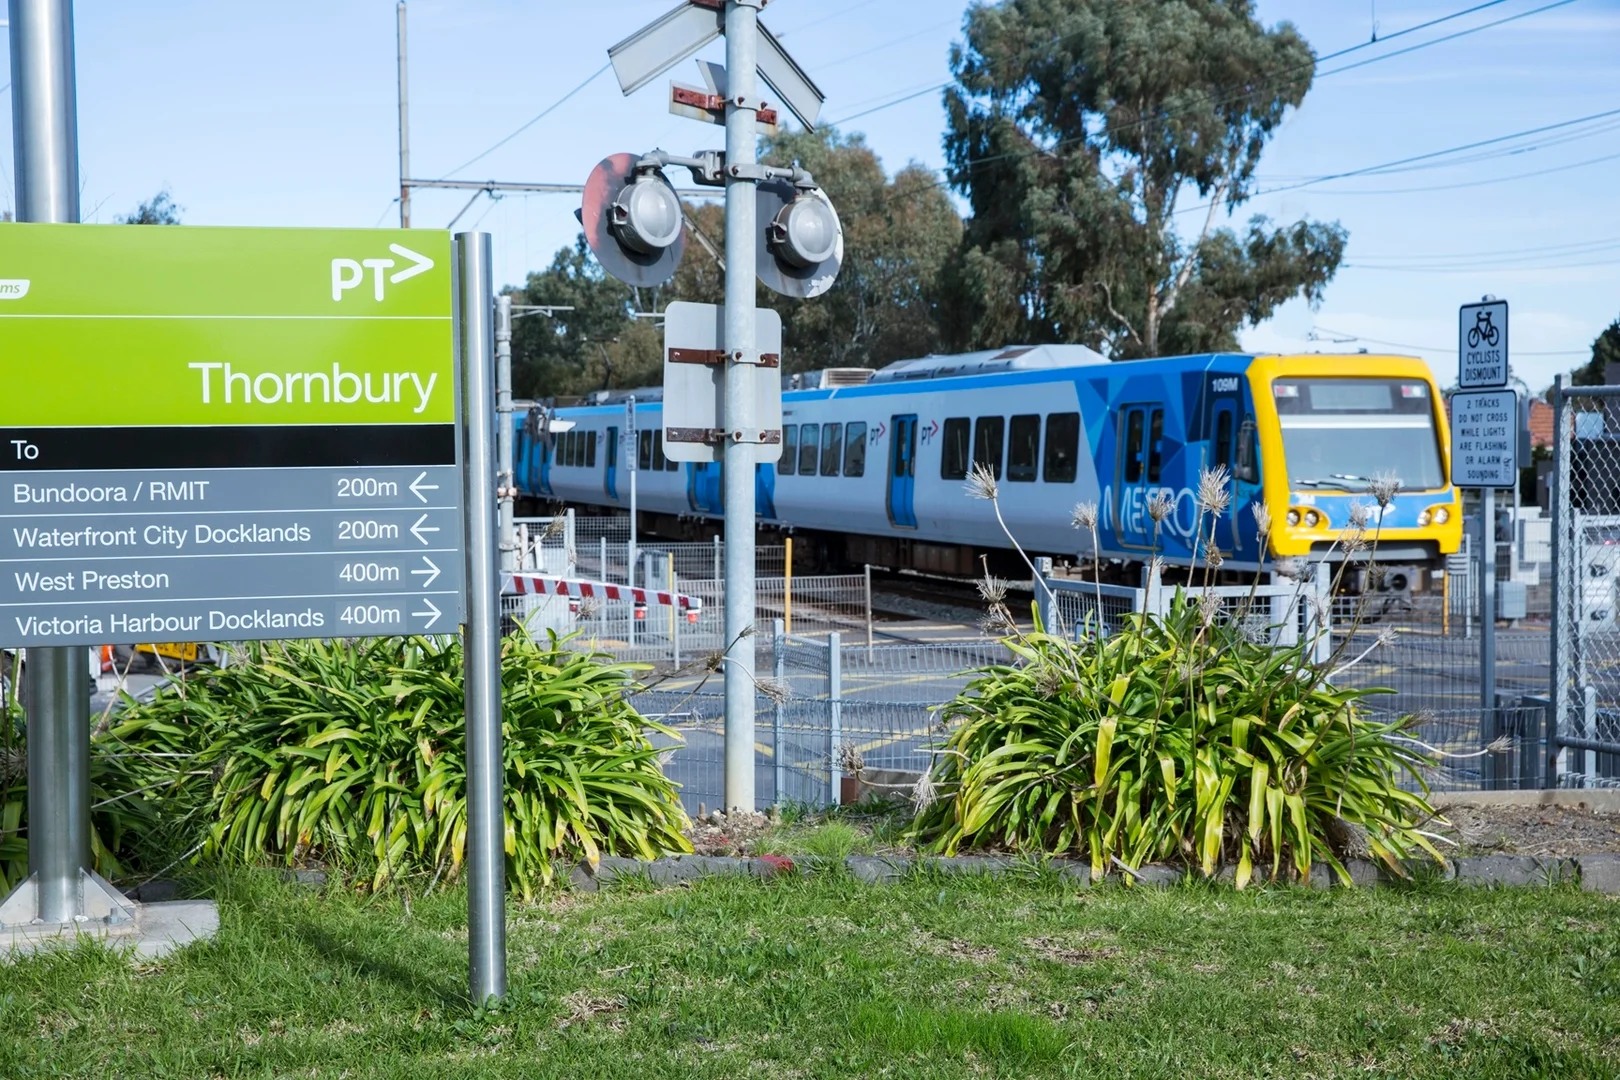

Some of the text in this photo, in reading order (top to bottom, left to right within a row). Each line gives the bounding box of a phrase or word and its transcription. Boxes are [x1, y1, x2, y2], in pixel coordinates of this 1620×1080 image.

[1467, 350, 1500, 365] CYCLISTS
[1465, 366, 1501, 381] DISMOUNT
[189, 363, 437, 413] Thornbury
[1212, 377, 1239, 392] 109M
[1467, 399, 1499, 409] 2 TRACKS
[1459, 413, 1508, 423] DO NOT CROSS
[1461, 427, 1506, 437] WHILE LIGHTS
[11, 440, 38, 459] To
[1460, 441, 1507, 451] ARE FLASHING
[1466, 455, 1500, 465] OR ALARM
[1467, 470, 1499, 479] SOUNDING
[14, 478, 397, 502] Bundoora / RMIT 200m
[14, 521, 398, 548] Waterfront City Docklands 200m
[15, 563, 398, 591] West Preston 400m
[16, 606, 399, 635] Victoria Harbour Docklands 400m
